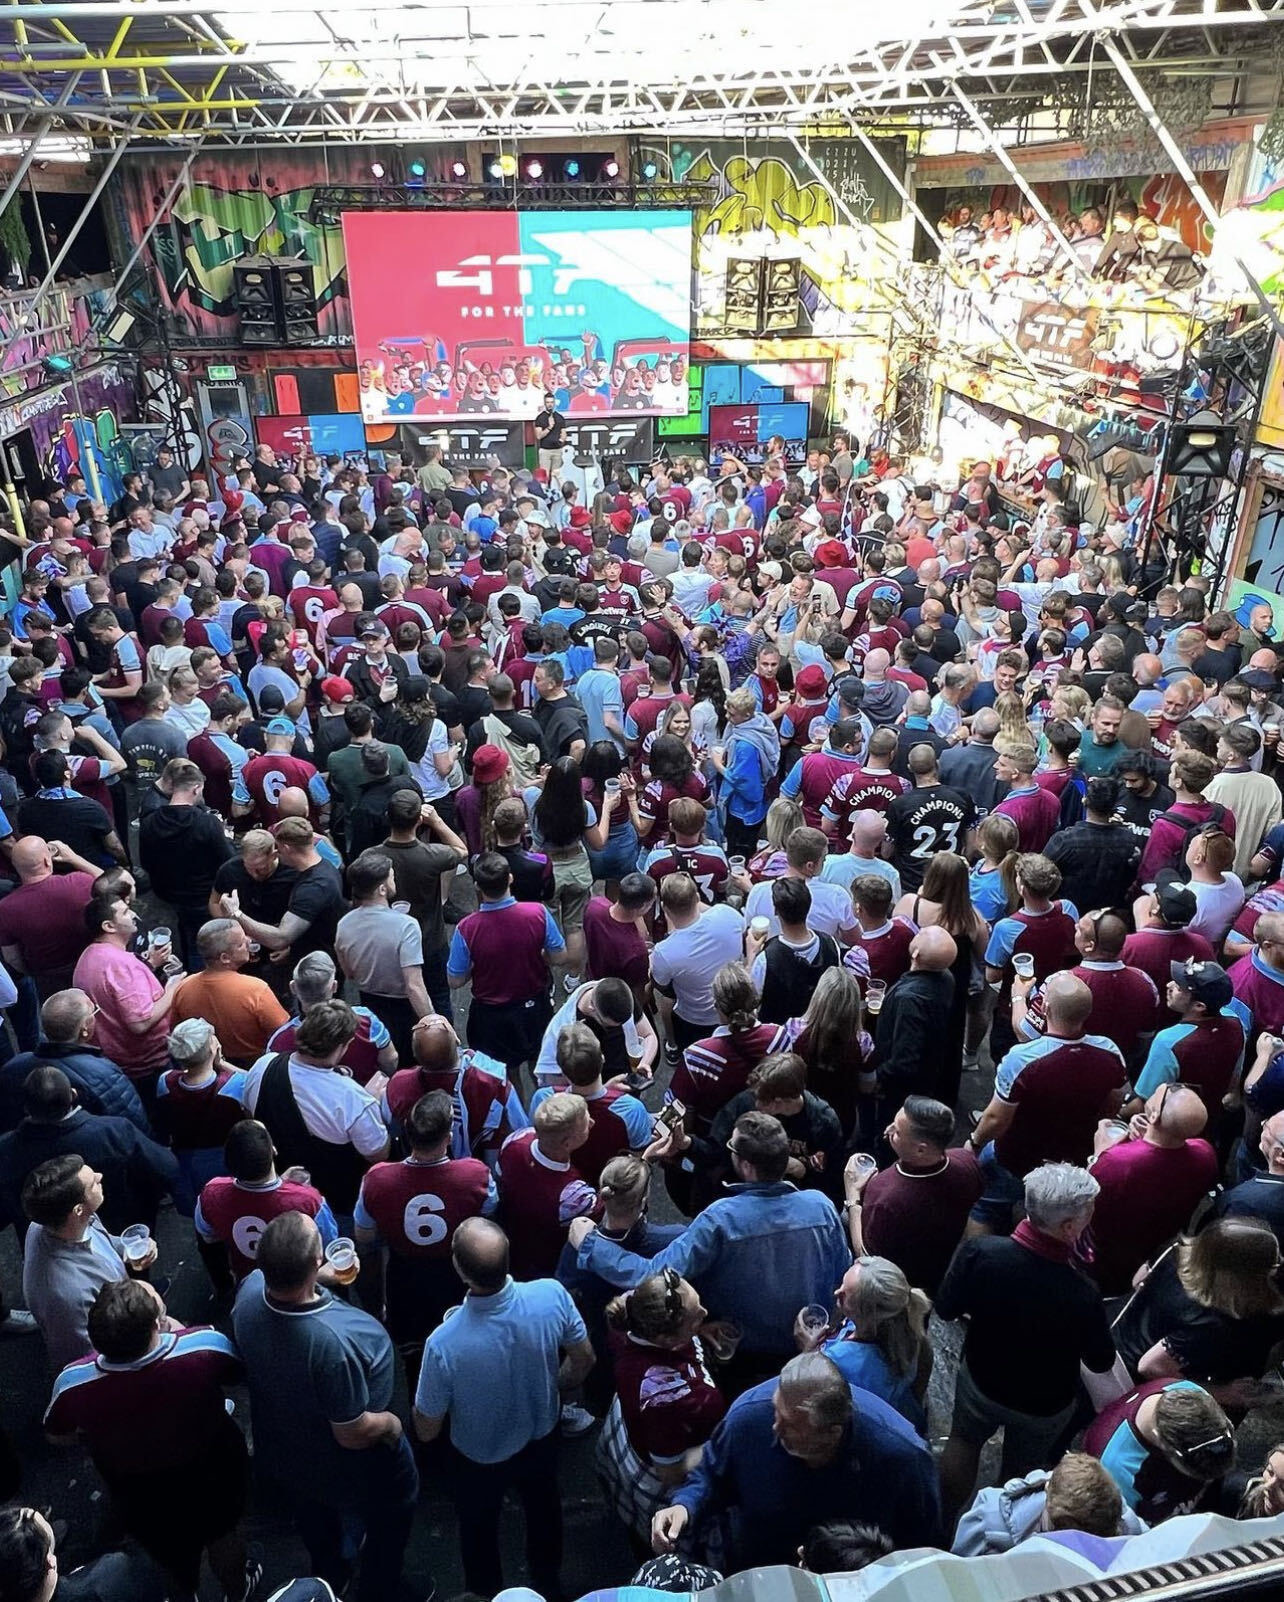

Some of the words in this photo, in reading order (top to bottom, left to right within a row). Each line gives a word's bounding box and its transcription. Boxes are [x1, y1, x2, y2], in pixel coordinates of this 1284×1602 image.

[461, 305, 494, 318] FOR
[503, 305, 535, 317] THE
[543, 304, 586, 317] FANS
[663, 501, 677, 522] 6
[742, 536, 755, 558] 6
[304, 597, 325, 623] 6
[263, 770, 287, 805] 6
[910, 800, 965, 825] CHAMPIONS
[910, 822, 960, 858] 23
[404, 1193, 448, 1247] 6
[232, 1215, 268, 1261] 6
